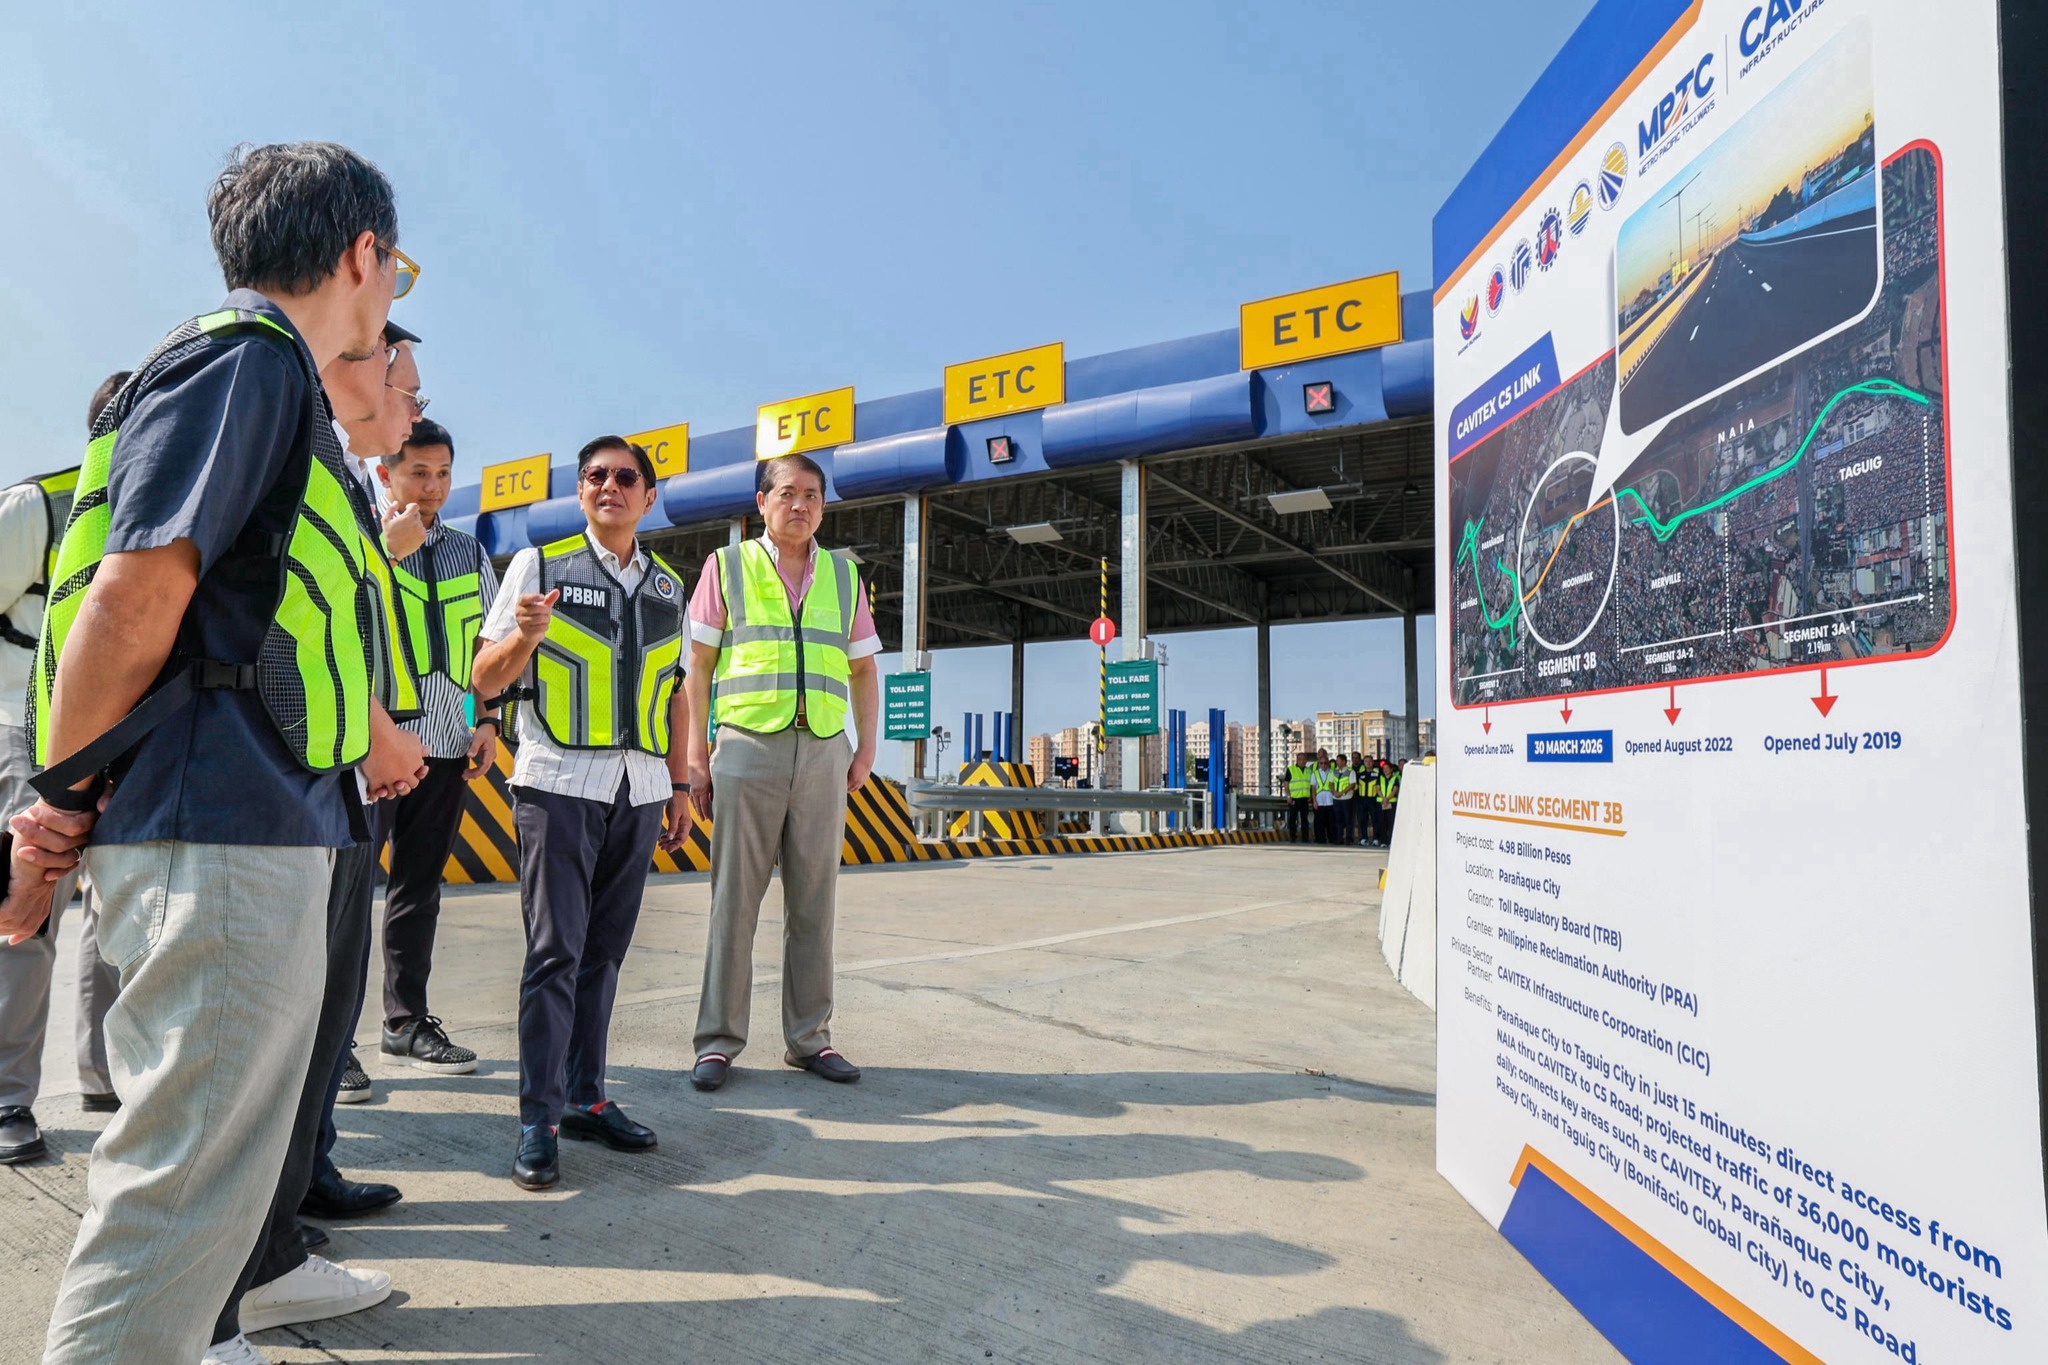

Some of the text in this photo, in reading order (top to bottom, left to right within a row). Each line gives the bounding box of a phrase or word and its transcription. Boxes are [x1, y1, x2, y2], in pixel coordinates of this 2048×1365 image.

[1638, 53, 1714, 158] MPTC
[1639, 100, 1715, 177] METRO PACIFIC TOLLWAYS
[1274, 300, 1362, 346] ETC
[969, 365, 1035, 404] ETC
[1457, 363, 1541, 440] CAVITEX C5 LINK
[777, 406, 831, 440] ETC
[494, 469, 532, 497] ETC
[1840, 456, 1882, 481] TAGUIG
[562, 585, 605, 607] PBBM
[1562, 572, 1594, 590] MOONWALK
[1651, 572, 1681, 590] MERVILLE
[1783, 621, 1856, 643] SEGMENT 3A-1
[1645, 647, 1694, 664] SEGMENT 3A-2
[1807, 641, 1831, 654] 2.19km
[1108, 675, 1150, 684] TOLL FARE
[1538, 652, 1597, 677] SEGMENT 3B
[1479, 680, 1494, 690] SEGMENT
[1464, 744, 1514, 755] Opened June 2024
[1534, 739, 1603, 754] 30 MARCH 2026
[1625, 737, 1733, 756] Opened August 2022
[1764, 731, 1901, 754] Opened July 2019
[1452, 790, 1623, 825] CAVITEX C5 LINK SEGMENT 3B
[1456, 832, 1572, 865] Project cost: 4.98 Billion Pesos
[1465, 860, 1561, 899] Location: Parañaque City
[1467, 889, 1622, 952] Grantor: Toll Regulatory Board (TRB)
[1451, 937, 1493, 965] Private Sector
[1466, 916, 1698, 1017] Grantee: Philippine Reclamation Authority (PRA)
[1467, 960, 1710, 1076] Partner: CAVITEX Infrastructure Corporation (CIC)
[1464, 987, 2002, 1279] Benefits: Parañaque City to Taguig City in just 15 minutes; direct access from
[1496, 1053, 1891, 1312] daily; connects key areas such as CAVITEX, Parañaque City,
[1497, 1028, 2013, 1331] NAIA thru CAVITEX to C5 Road; projected traffic of 36,000 motorists
[1496, 1076, 1519, 1104] Pasay
[1521, 1093, 1540, 1119] City,
[1542, 1109, 1559, 1129] and
[1561, 1118, 1596, 1157] Taguig
[1598, 1143, 1621, 1173] City
[1624, 1158, 1689, 1216] (Bonifacio
[1693, 1205, 1741, 1252] Global
[1747, 1240, 1788, 1287] City)
[1794, 1269, 1815, 1299] to
[1821, 1287, 1848, 1321] C5
